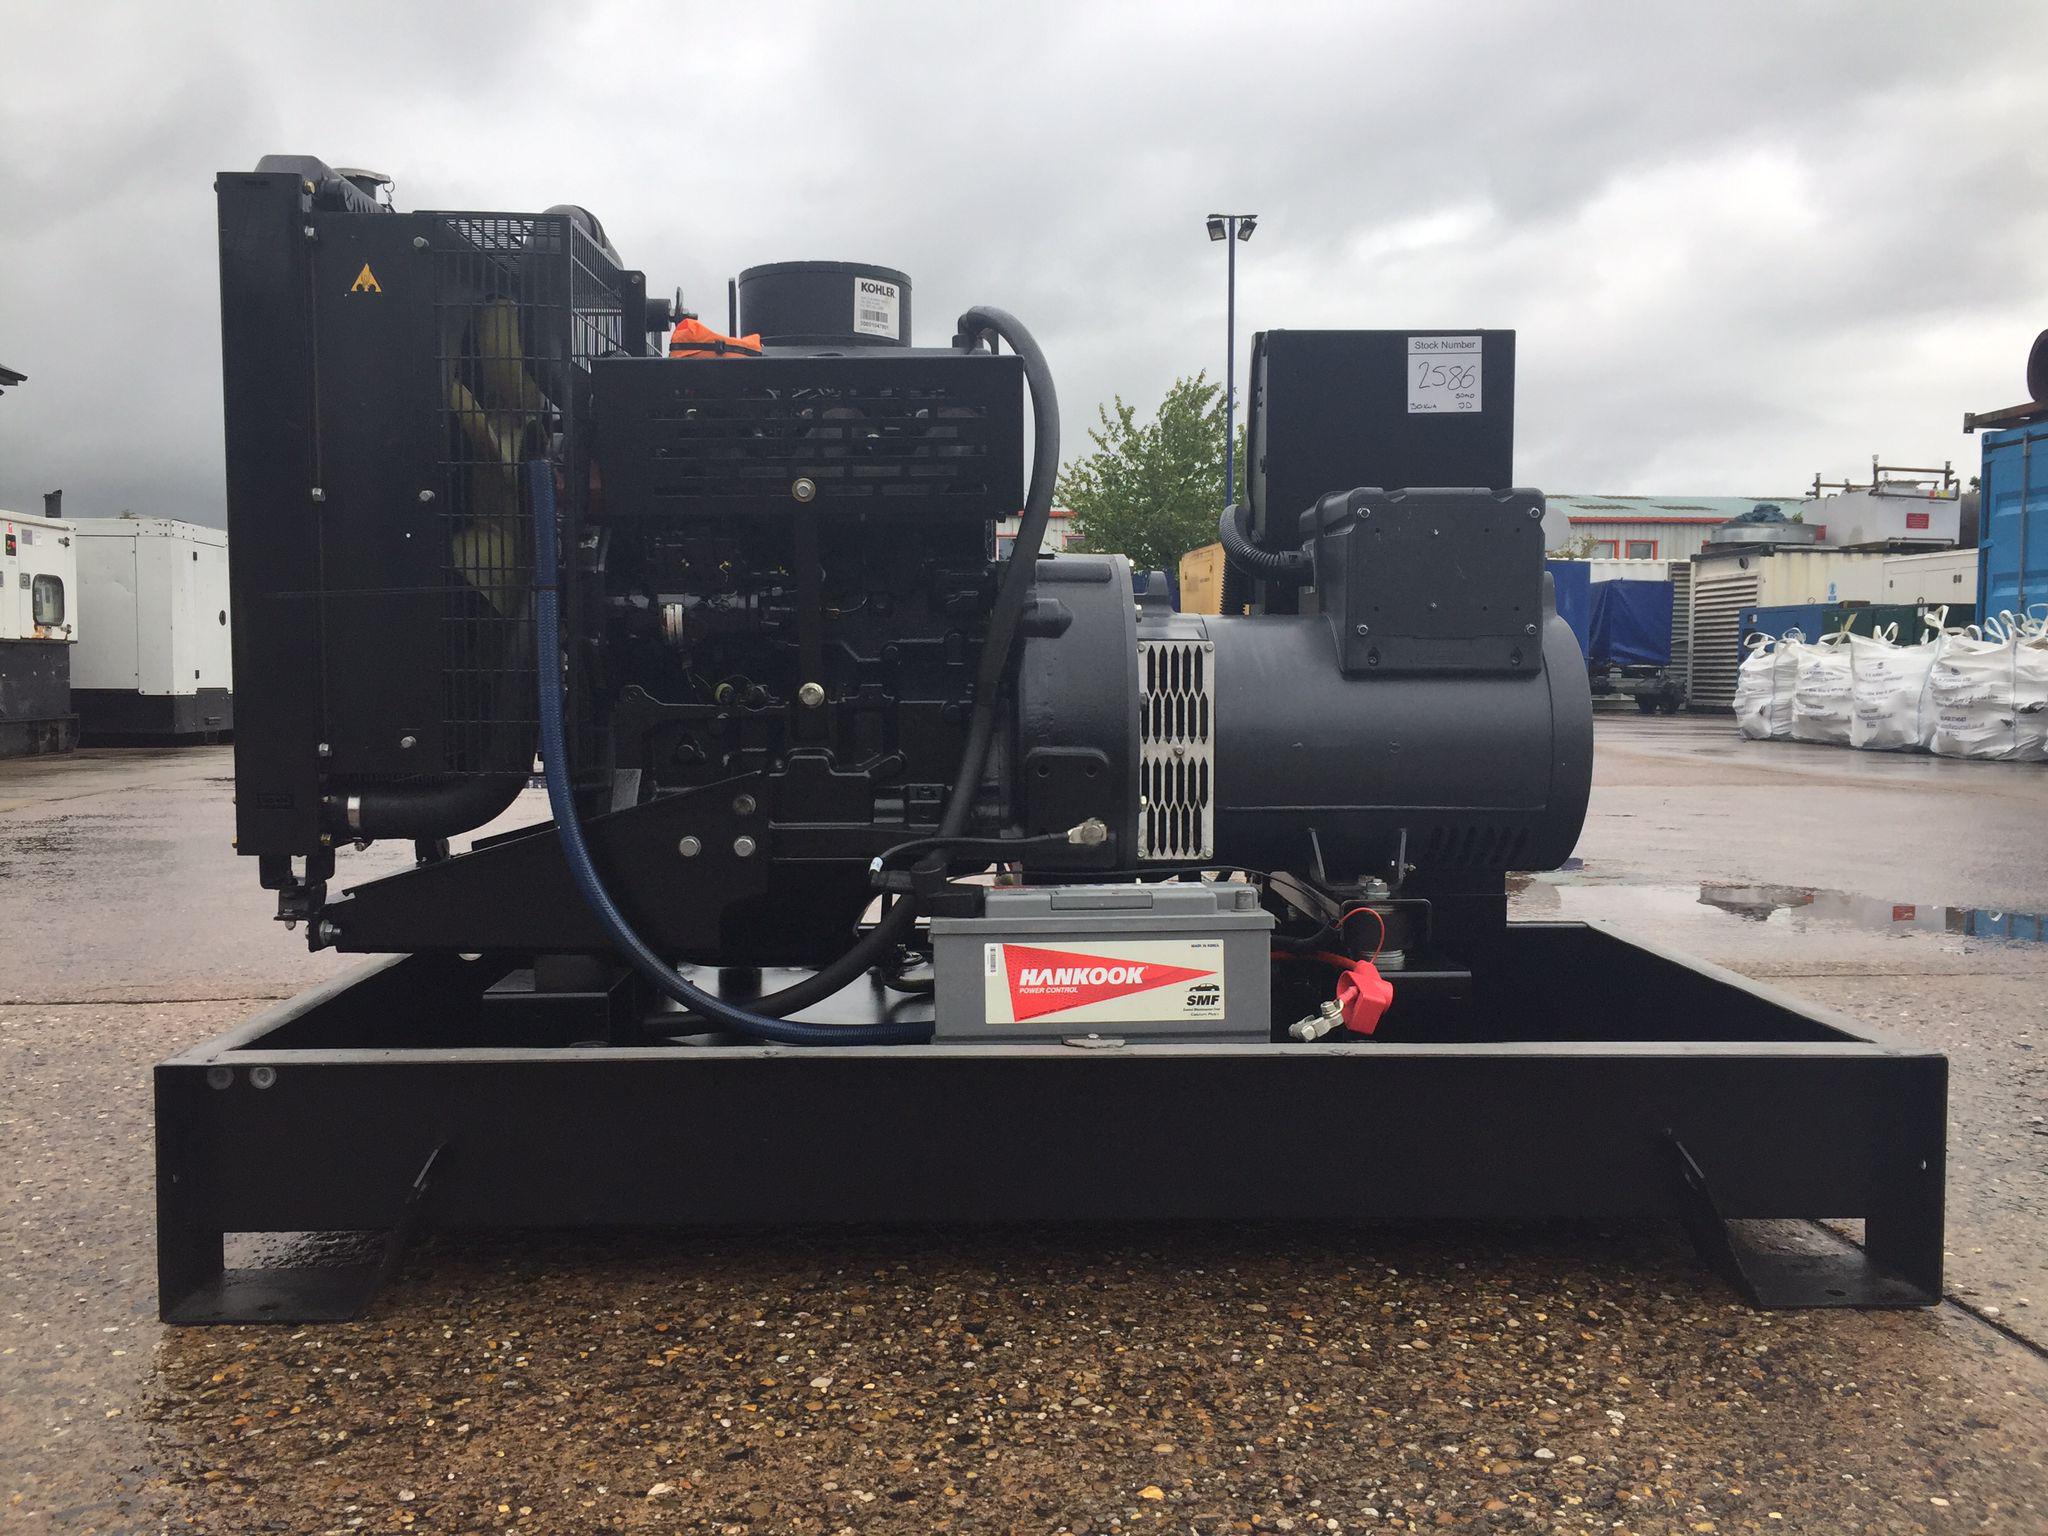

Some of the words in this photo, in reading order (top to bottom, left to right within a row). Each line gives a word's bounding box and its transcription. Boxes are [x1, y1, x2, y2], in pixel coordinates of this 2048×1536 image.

[861, 282, 896, 298] KOHLER
[1414, 340, 1439, 349] Stock
[1441, 340, 1476, 349] Number
[1418, 361, 1476, 391] 2586
[1019, 966, 1145, 985] HANKOOK
[1186, 994, 1220, 1006] SMF
